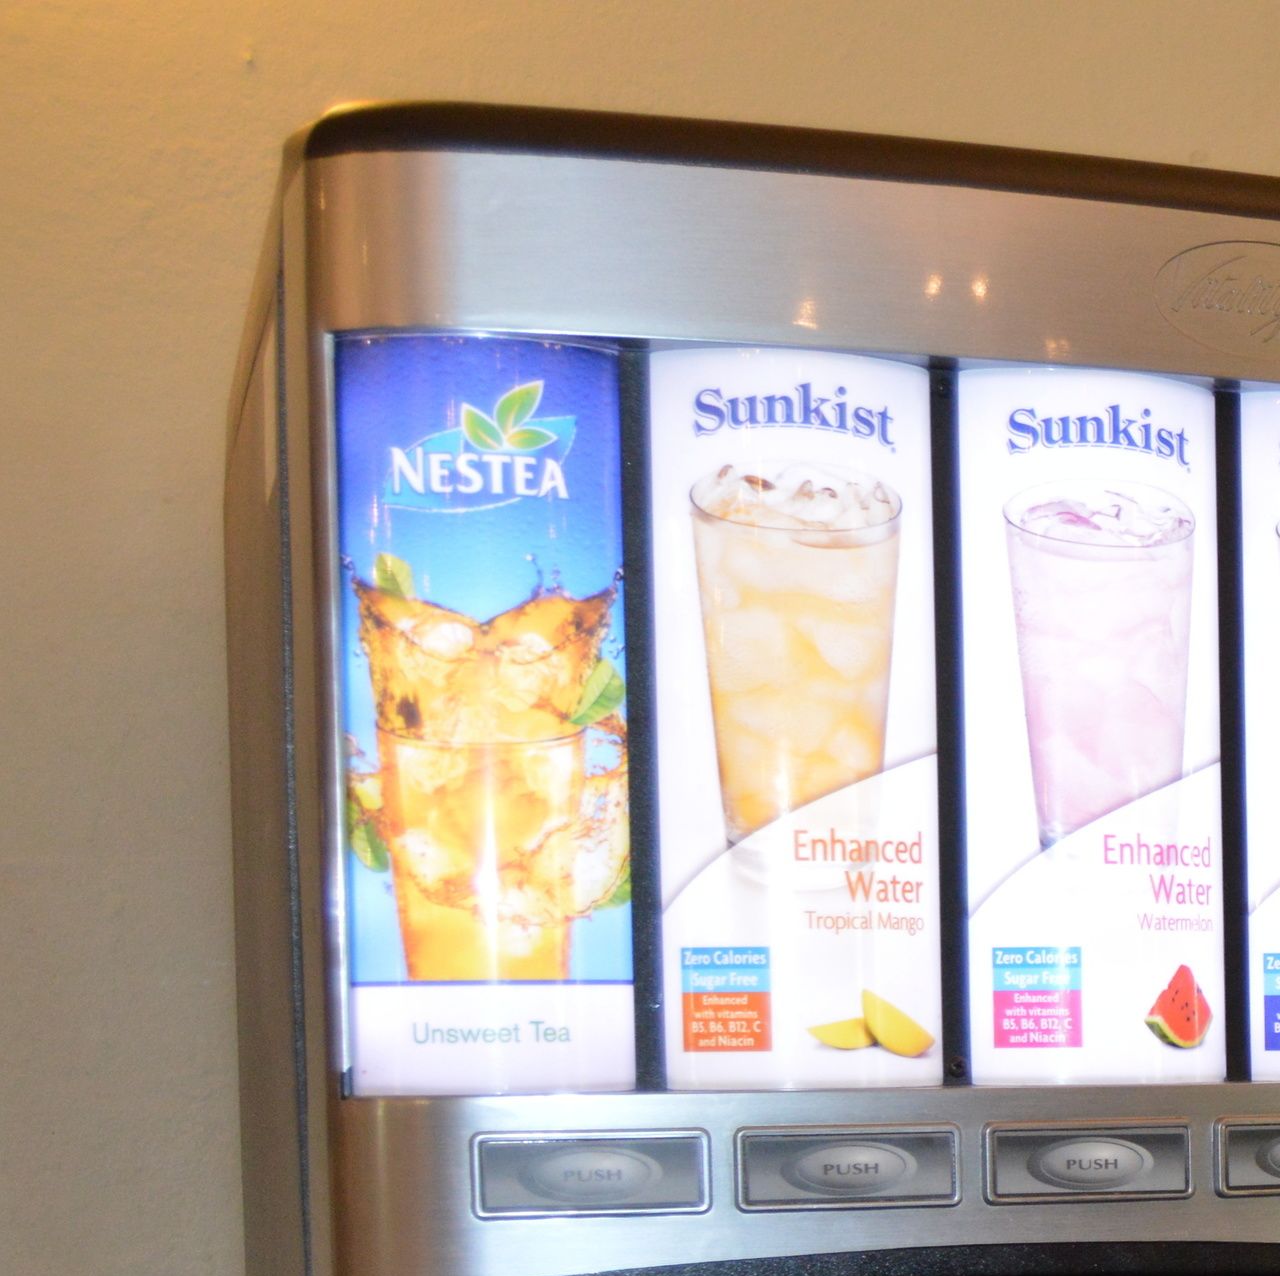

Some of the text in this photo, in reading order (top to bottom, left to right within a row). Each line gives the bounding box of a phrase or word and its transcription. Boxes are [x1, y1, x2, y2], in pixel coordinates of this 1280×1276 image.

[693, 382, 897, 446] Sunkist
[1006, 404, 1190, 467] Sunkist
[389, 446, 569, 499] NESTEA
[793, 828, 923, 864] Enhanced
[1103, 833, 1211, 868] Enhanced
[844, 870, 924, 904] Water
[1149, 874, 1212, 905] Water
[804, 910, 925, 936] Tropical Mango
[1136, 912, 1213, 932] Watermelon
[684, 950, 767, 965] Zero Calories
[995, 949, 1078, 965] Zero Calores
[691, 972, 759, 990] Sugar Free
[1004, 971, 1040, 988] Sugar
[703, 994, 748, 1005] Enhanced
[1013, 992, 1060, 1003] Enhanced
[412, 1020, 571, 1046] Unsweet Tea
[698, 1035, 754, 1047] and Niacin
[1009, 1031, 1066, 1043] and Niacin
[822, 1160, 880, 1178] PUSH
[1065, 1156, 1119, 1171] PUSH
[562, 1168, 623, 1186] PUSH
